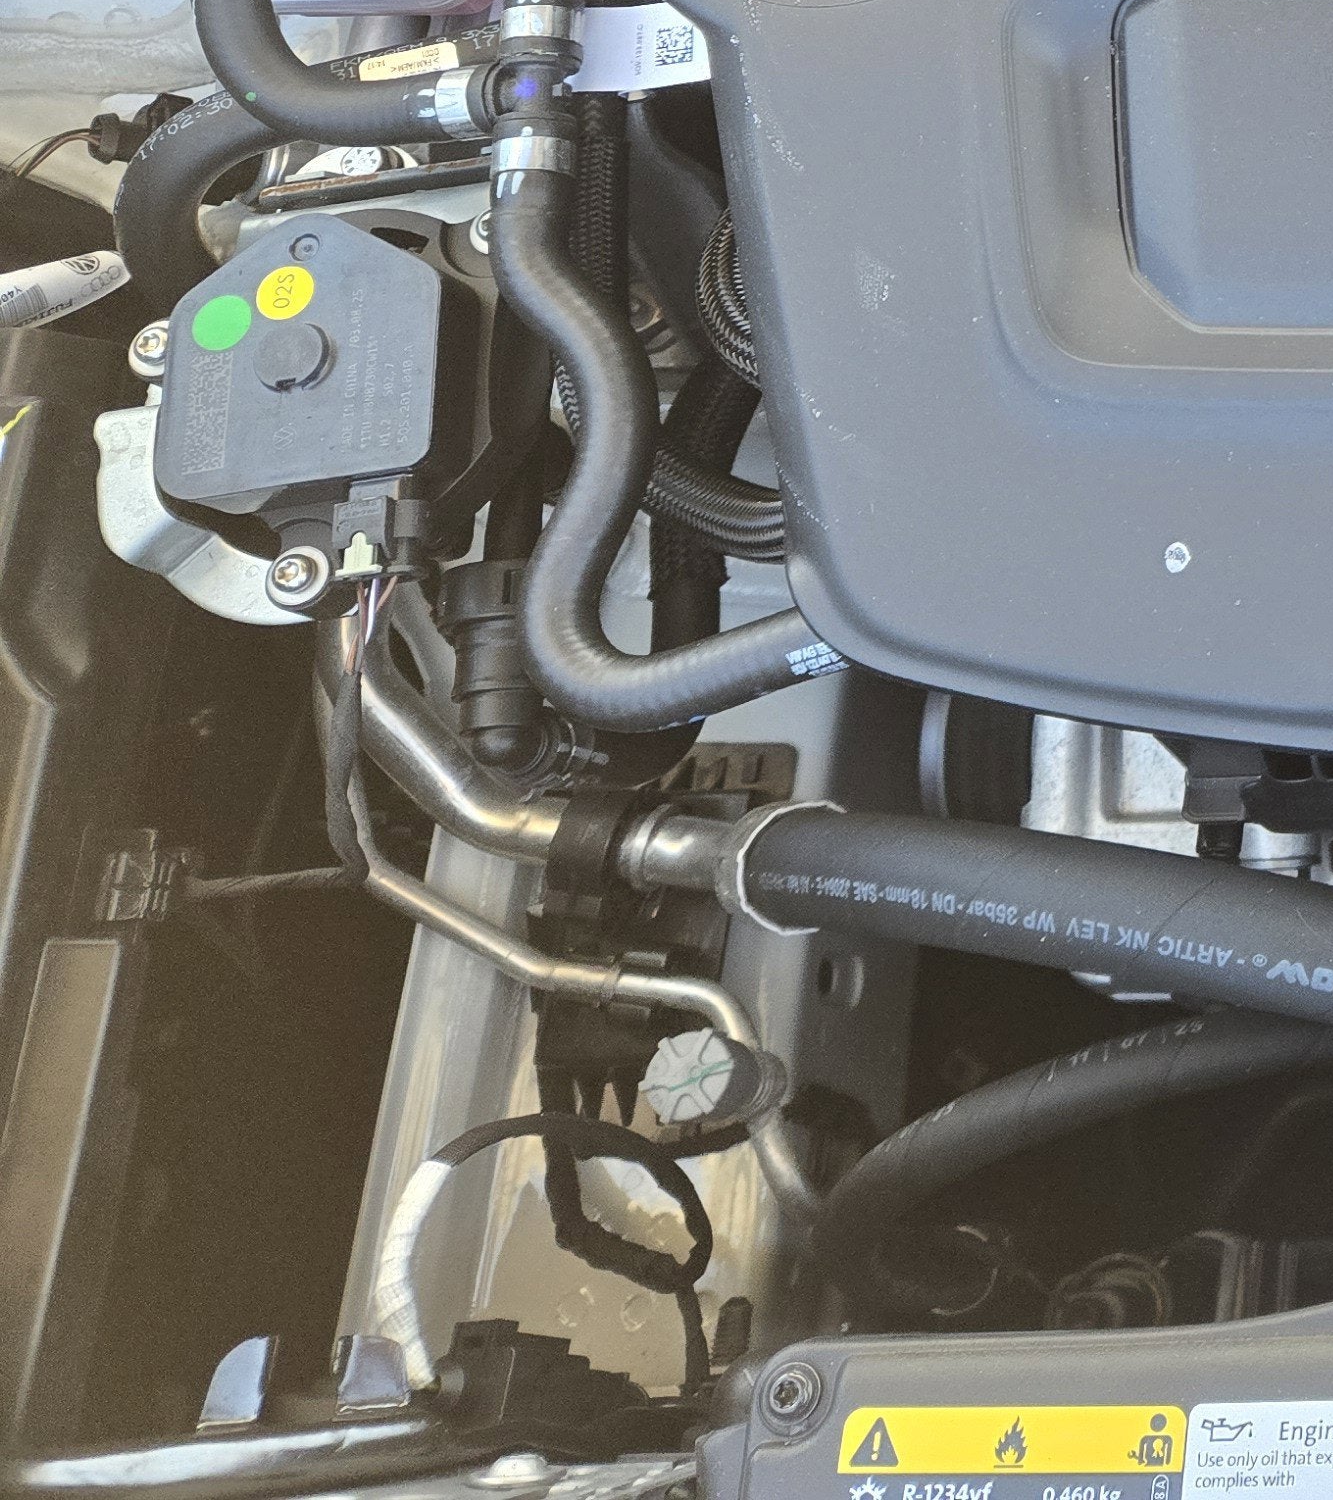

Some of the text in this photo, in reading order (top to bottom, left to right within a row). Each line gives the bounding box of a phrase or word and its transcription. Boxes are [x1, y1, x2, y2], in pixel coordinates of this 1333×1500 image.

[965, 898, 1019, 925] 35bar
[1022, 908, 1058, 932] WP
[1064, 916, 1110, 942] LEV
[1114, 925, 1150, 952] NK
[1155, 933, 1233, 968] ARTIC
[1197, 1451, 1224, 1468] Use
[1226, 1449, 1259, 1471] only
[1260, 1449, 1279, 1467] oil
[1281, 1449, 1313, 1467] that
[1195, 1470, 1295, 1491] complies with
